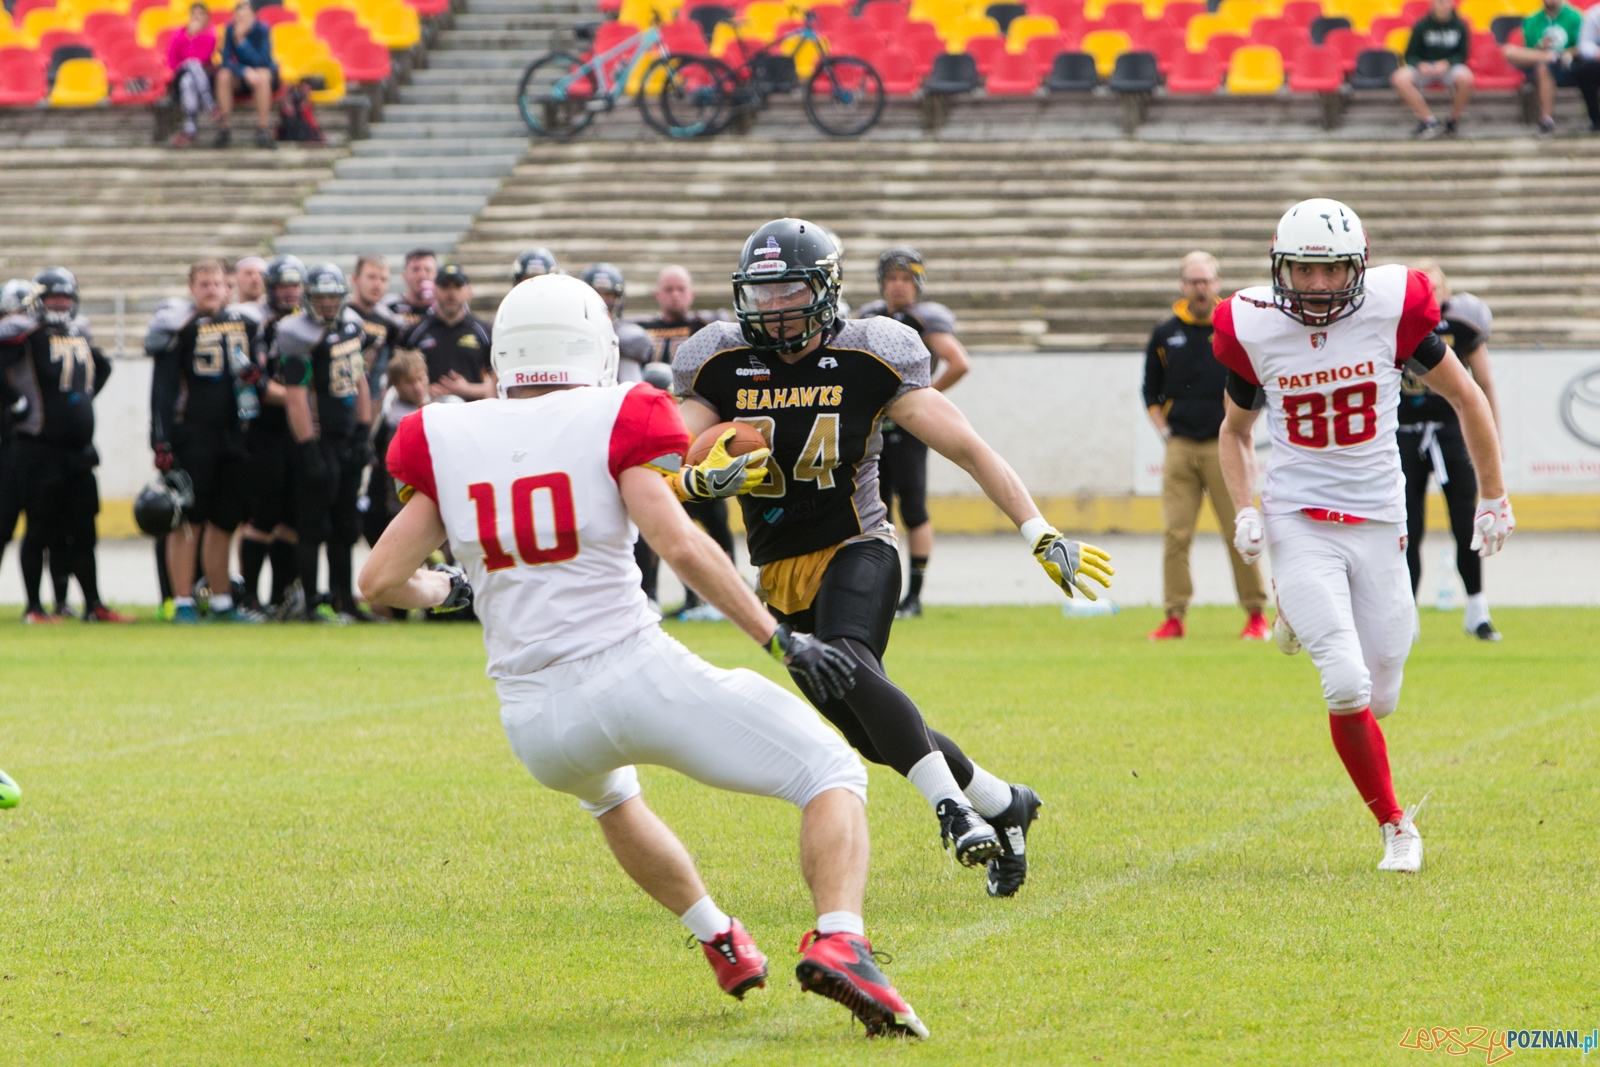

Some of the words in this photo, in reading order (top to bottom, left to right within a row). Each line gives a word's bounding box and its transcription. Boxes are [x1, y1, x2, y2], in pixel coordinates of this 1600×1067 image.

[756, 262, 778, 270] Riddell
[515, 371, 569, 384] Riddell
[735, 367, 771, 376] GDYNIA
[1278, 361, 1375, 389] PATRIOCI
[736, 385, 843, 410] SEAHAWKS
[1282, 381, 1378, 449] 88
[468, 471, 580, 573] 10
